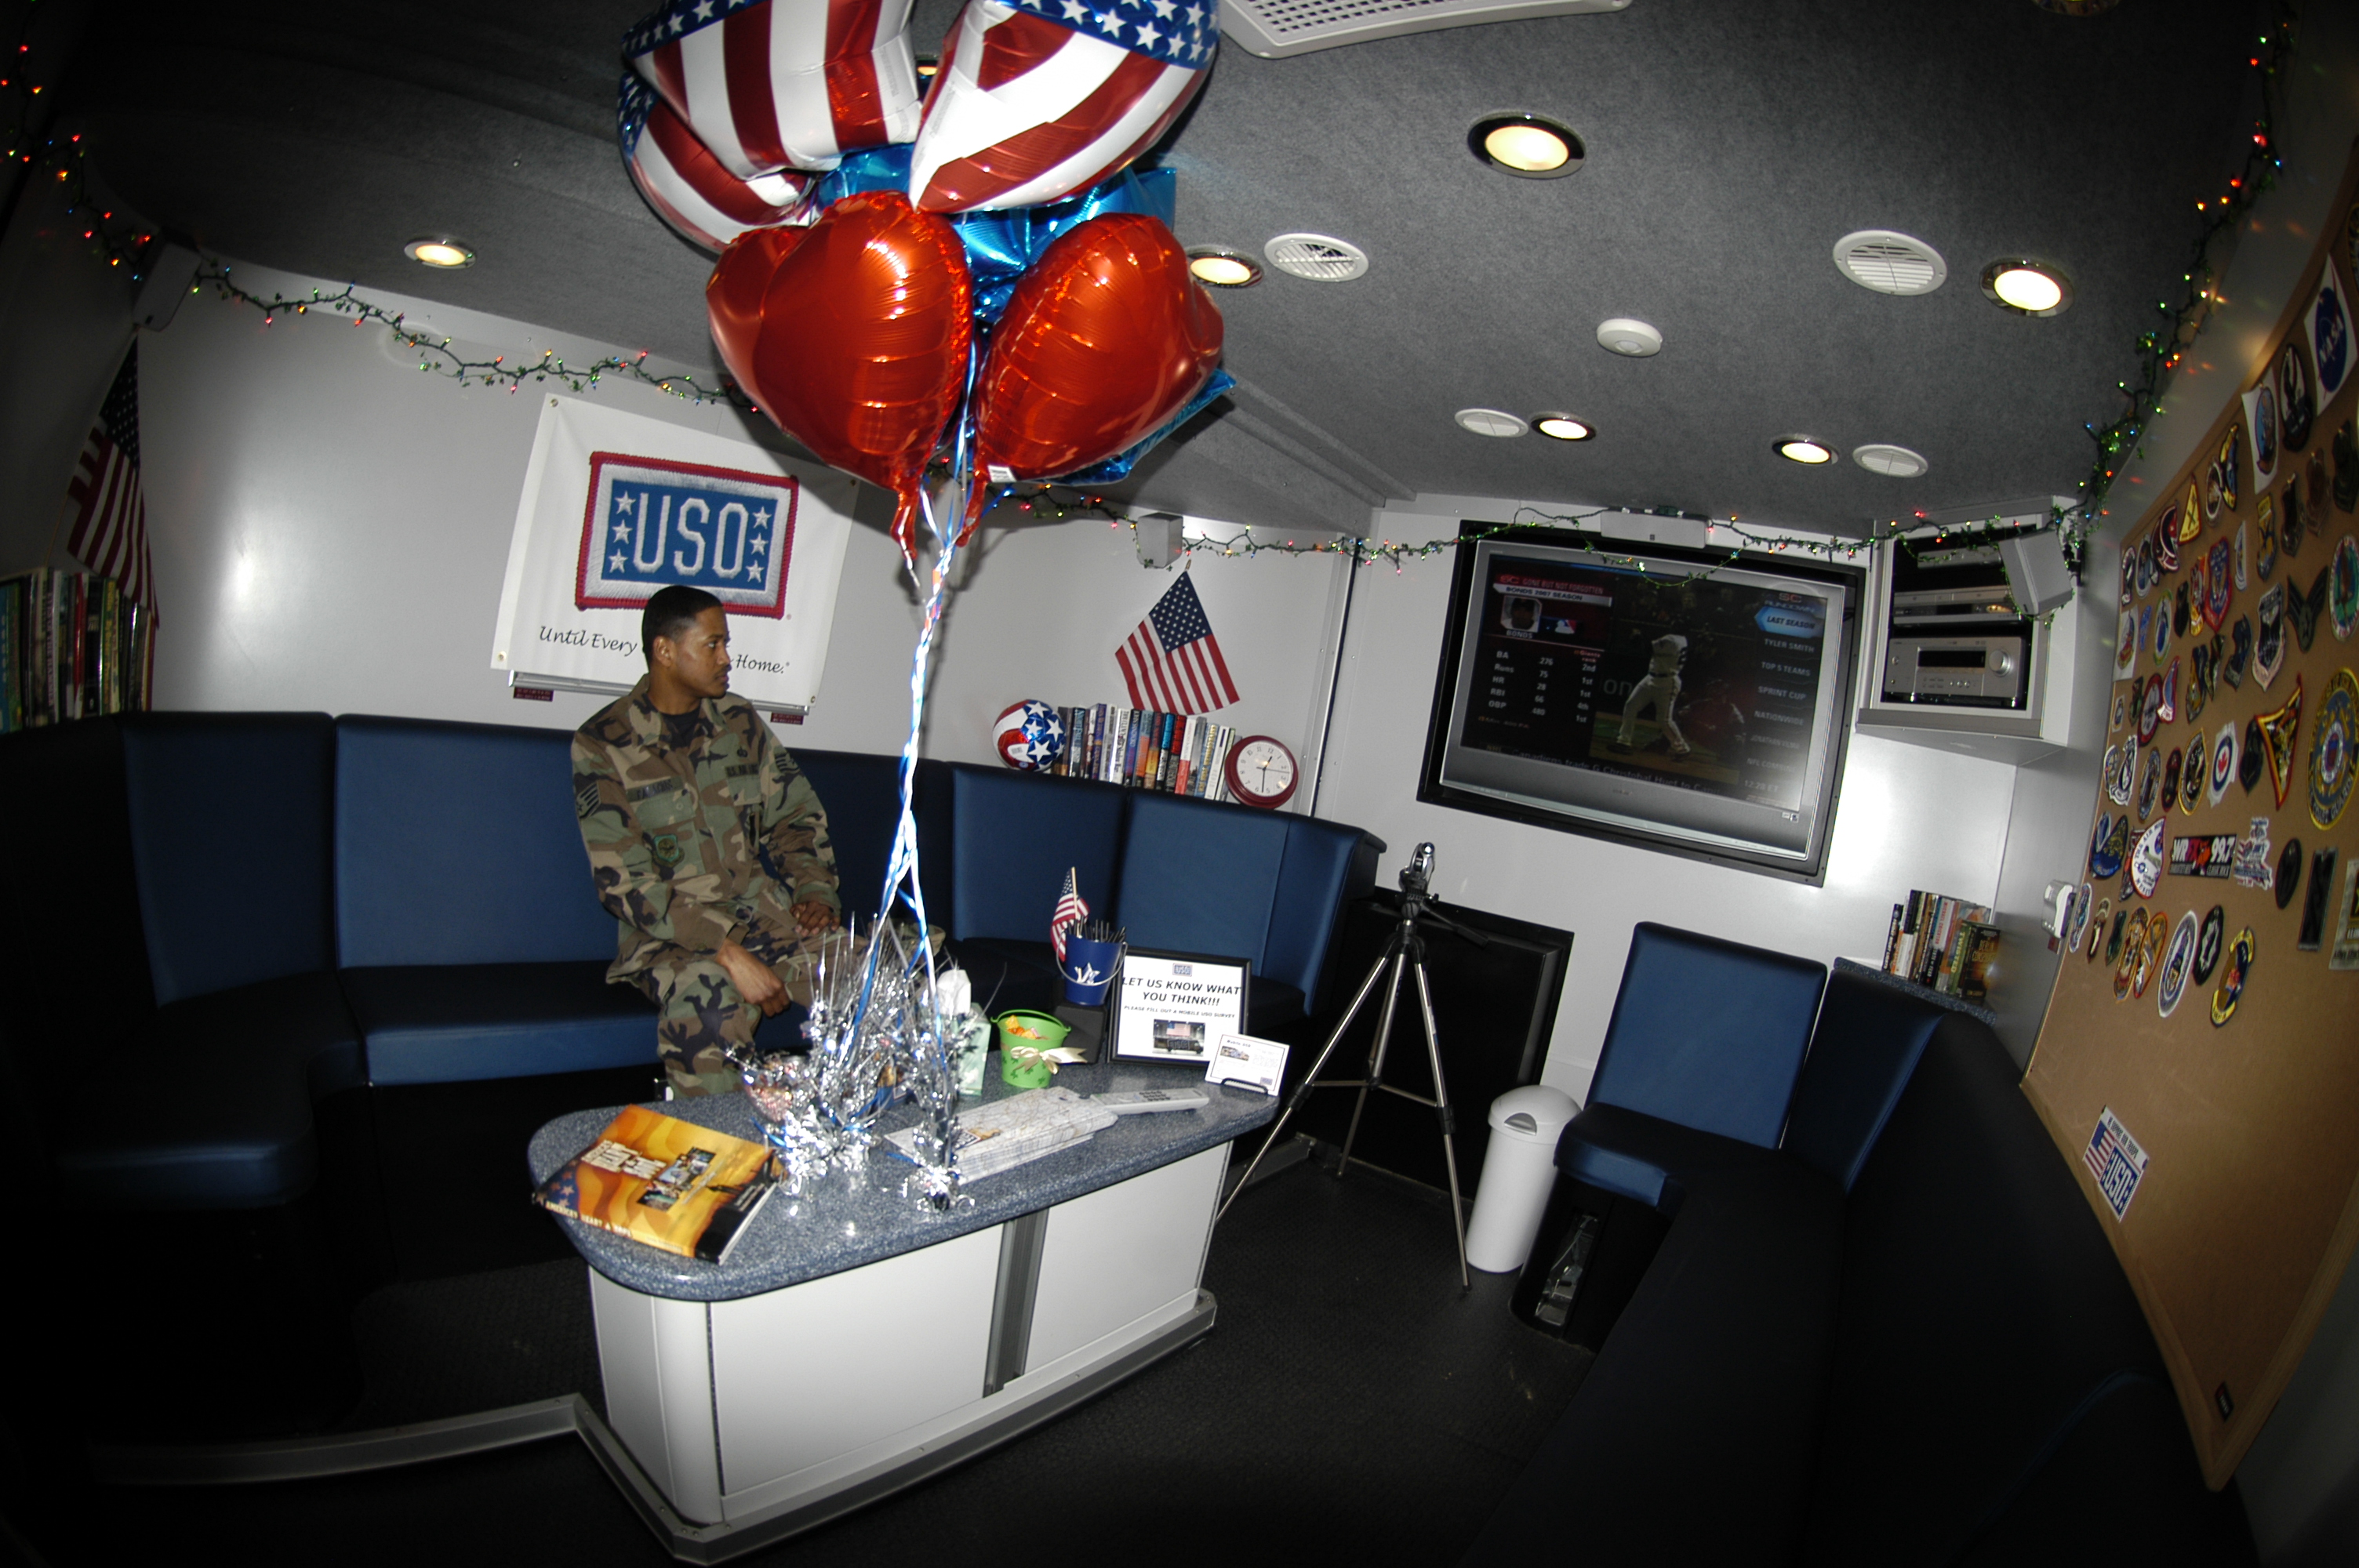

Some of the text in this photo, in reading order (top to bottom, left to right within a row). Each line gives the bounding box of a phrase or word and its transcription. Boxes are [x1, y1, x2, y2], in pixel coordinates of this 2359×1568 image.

[2319, 315, 2343, 370] NASA
[633, 492, 748, 579] USO
[1506, 586, 1532, 595] BONDS
[1554, 592, 1583, 601] SEASON
[1522, 578, 1541, 587] GONE
[1542, 580, 1554, 589] BUT
[1555, 581, 1568, 590] NOT
[1568, 583, 1604, 594] FORGOTTEN
[1767, 615, 1816, 629] LAST SEASON
[540, 626, 589, 647] Until
[591, 633, 638, 656] Every
[1506, 630, 1532, 639] BONDS
[1764, 638, 1816, 653] TYLER SMITH
[1496, 651, 1509, 659] BA
[1494, 662, 1597, 678] Runs 75 2nd
[1761, 662, 1776, 670] TOP
[1784, 665, 1811, 677] TEAMS
[1492, 676, 1593, 691] HR 28 1st
[1490, 688, 1506, 697] RBI
[1579, 689, 1591, 699] 1st
[1757, 686, 1807, 700] SPRINT CUP
[1488, 700, 1507, 710] OBP
[1576, 714, 1588, 723] 1st
[1754, 710, 1805, 726] NATIONWIDE
[2210, 836, 2236, 863] 99.7
[1950, 931, 1965, 974] TWISTED
[1122, 977, 1241, 995] LET US KNOW WHAT
[1143, 992, 1220, 1006] YOU THINK!!!
[2105, 1151, 2132, 1207] USO
[580, 1213, 602, 1228] HEART
